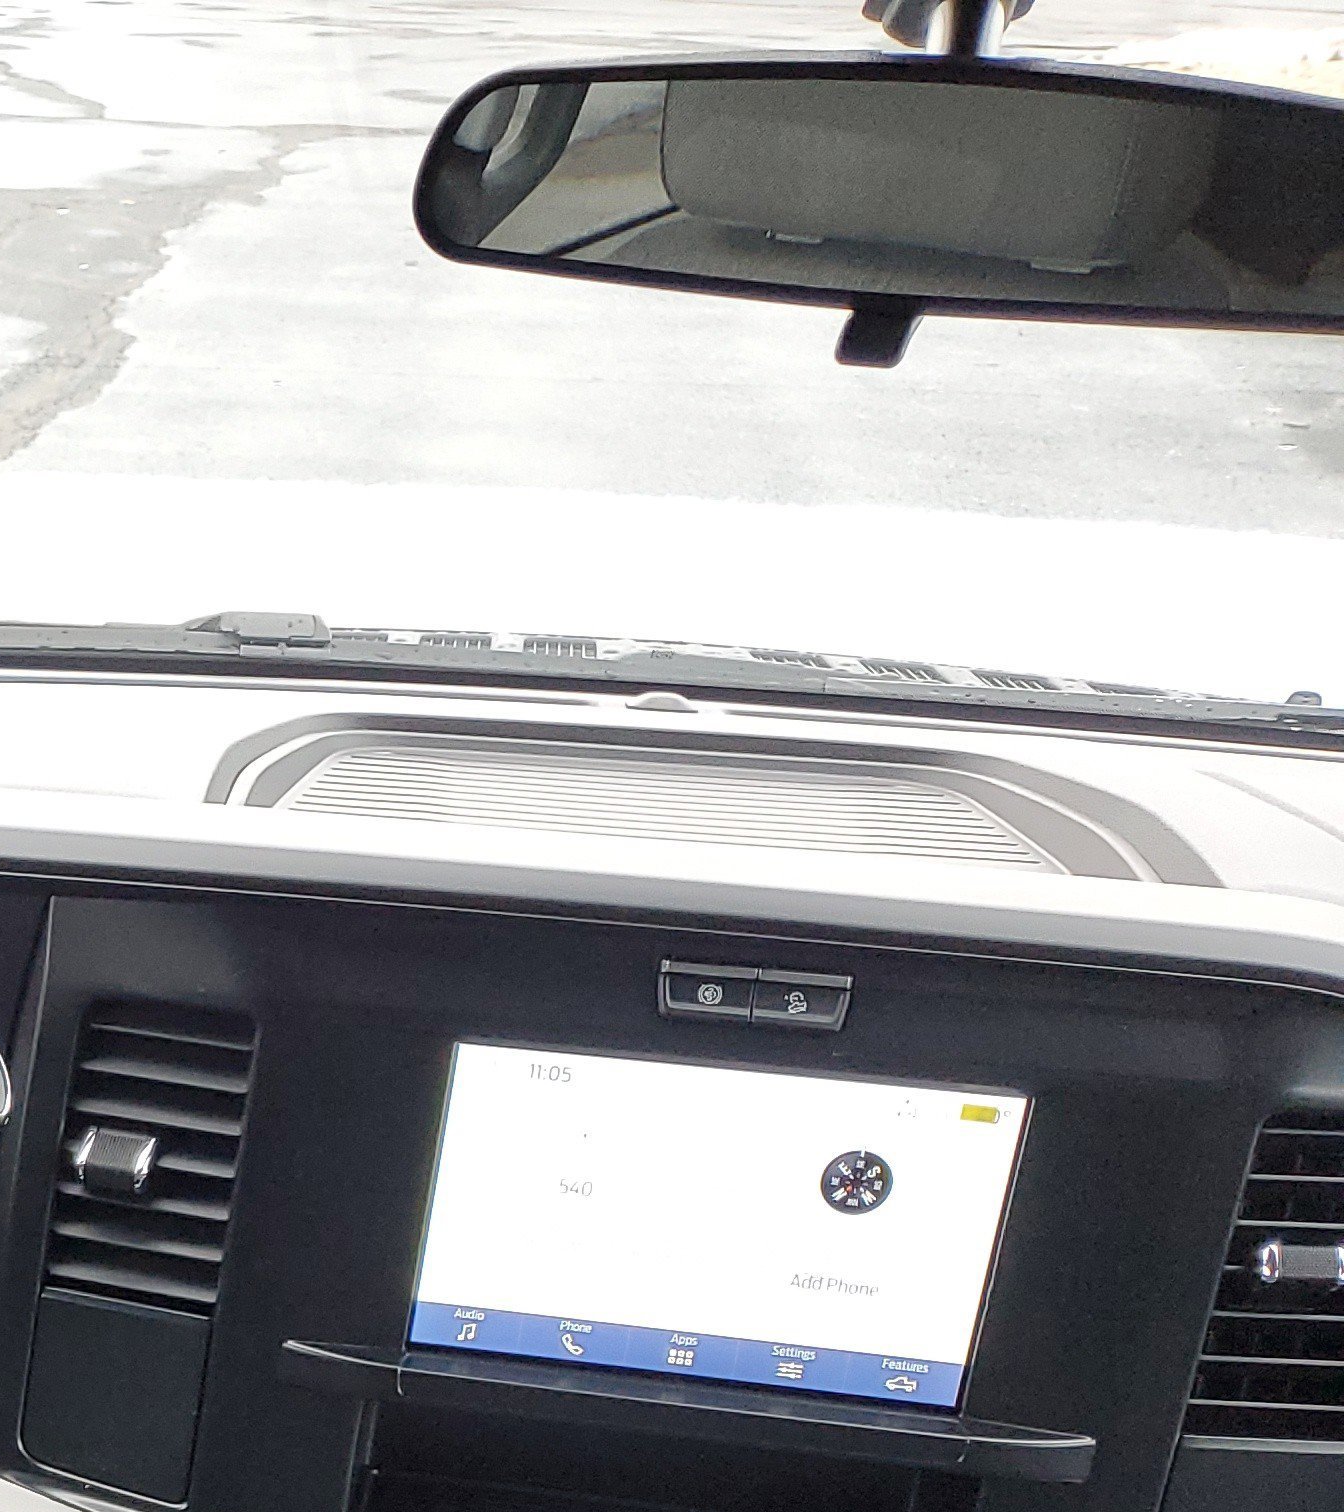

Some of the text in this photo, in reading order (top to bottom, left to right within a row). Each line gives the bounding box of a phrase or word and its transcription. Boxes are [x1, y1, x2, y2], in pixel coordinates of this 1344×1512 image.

[530, 1063, 572, 1083] 11:05
[560, 1179, 593, 1197] 540
[790, 1273, 879, 1297] Add Phone
[454, 1308, 485, 1321] Audio
[559, 1320, 592, 1334] Phone
[670, 1333, 698, 1347] Apps
[771, 1345, 816, 1361] Settings
[882, 1358, 929, 1374] Features
